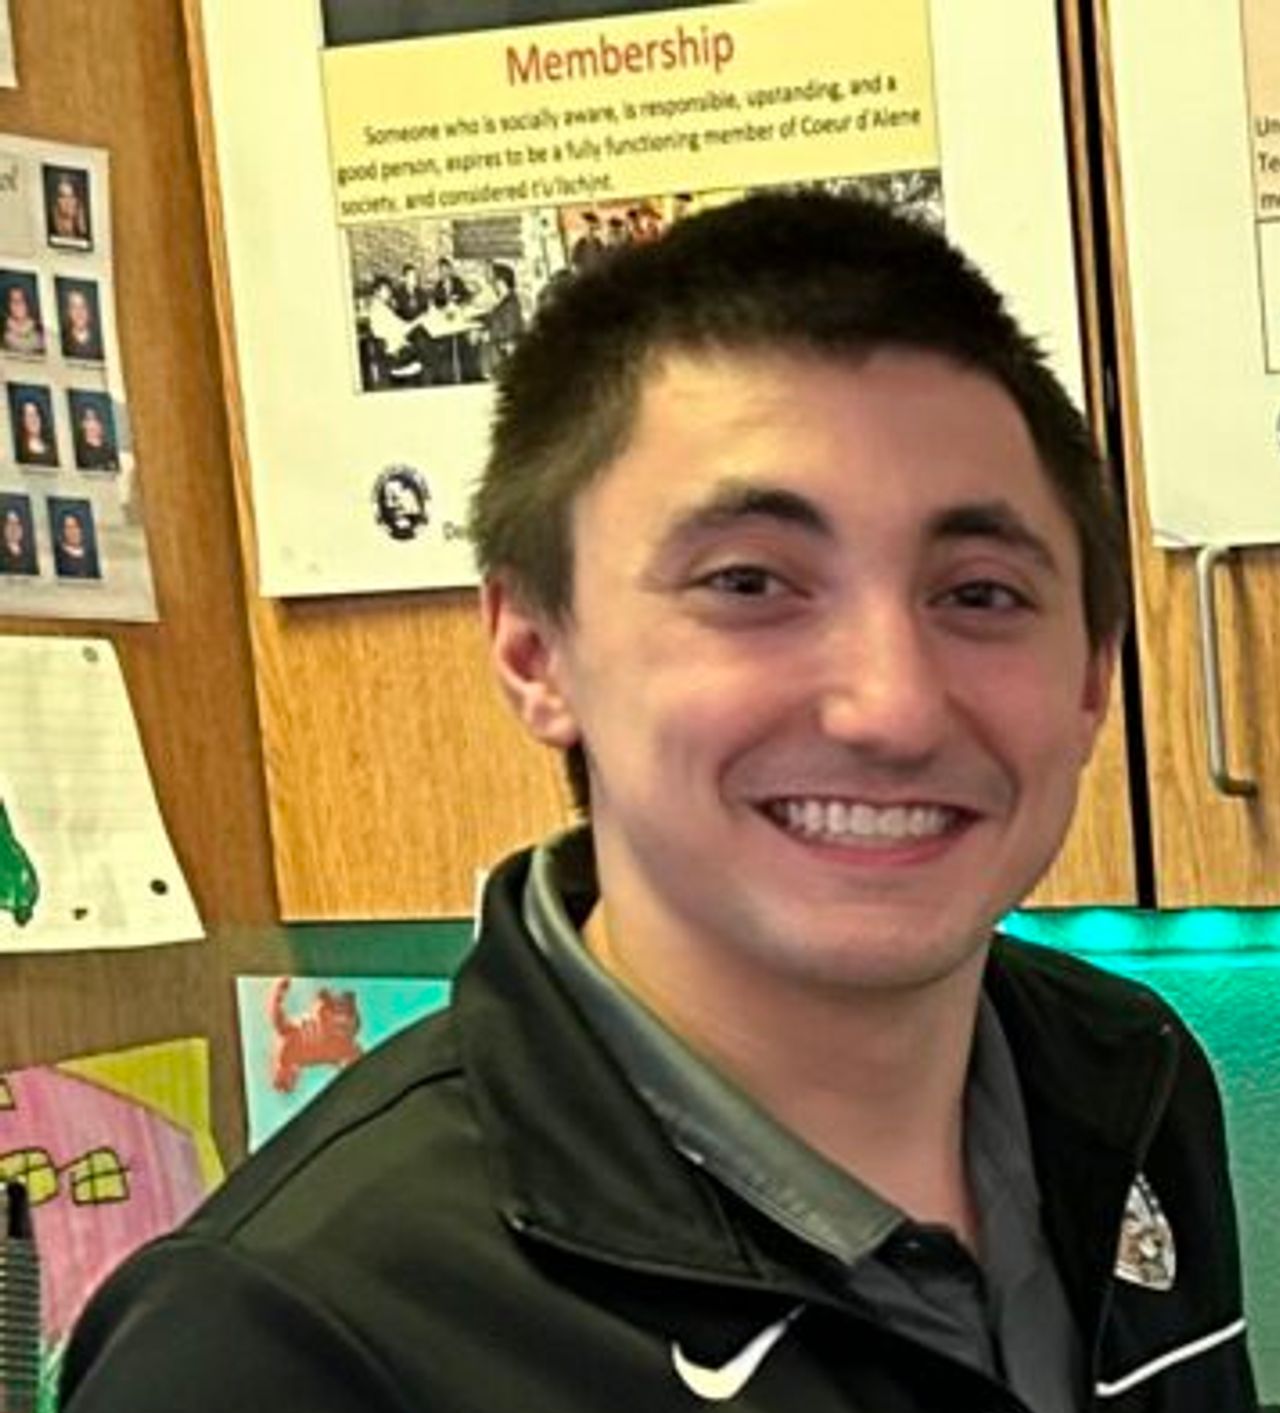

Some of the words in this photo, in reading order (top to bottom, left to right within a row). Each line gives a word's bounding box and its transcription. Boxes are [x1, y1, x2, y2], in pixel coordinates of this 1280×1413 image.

[506, 25, 734, 86] Membership
[363, 117, 440, 146] Someone
[445, 118, 479, 138] who
[484, 115, 497, 134] is
[501, 108, 558, 132] socially
[564, 103, 619, 126] aware,
[623, 101, 637, 119] is
[640, 90, 741, 118] responsible,
[747, 80, 844, 108] upstanding,
[850, 76, 881, 96] and
[887, 76, 897, 92] a
[338, 164, 377, 187] good
[381, 158, 441, 182] person,
[446, 148, 501, 173] aspires
[507, 147, 523, 166] to
[528, 145, 548, 163] be
[553, 147, 562, 161] a
[566, 140, 602, 164] fully
[604, 131, 700, 155] functioning
[704, 124, 773, 146] member
[779, 118, 797, 140] of
[801, 114, 852, 136] Coeur
[856, 107, 921, 132] d'Alene
[405, 190, 436, 210] and
[438, 180, 528, 207] considered
